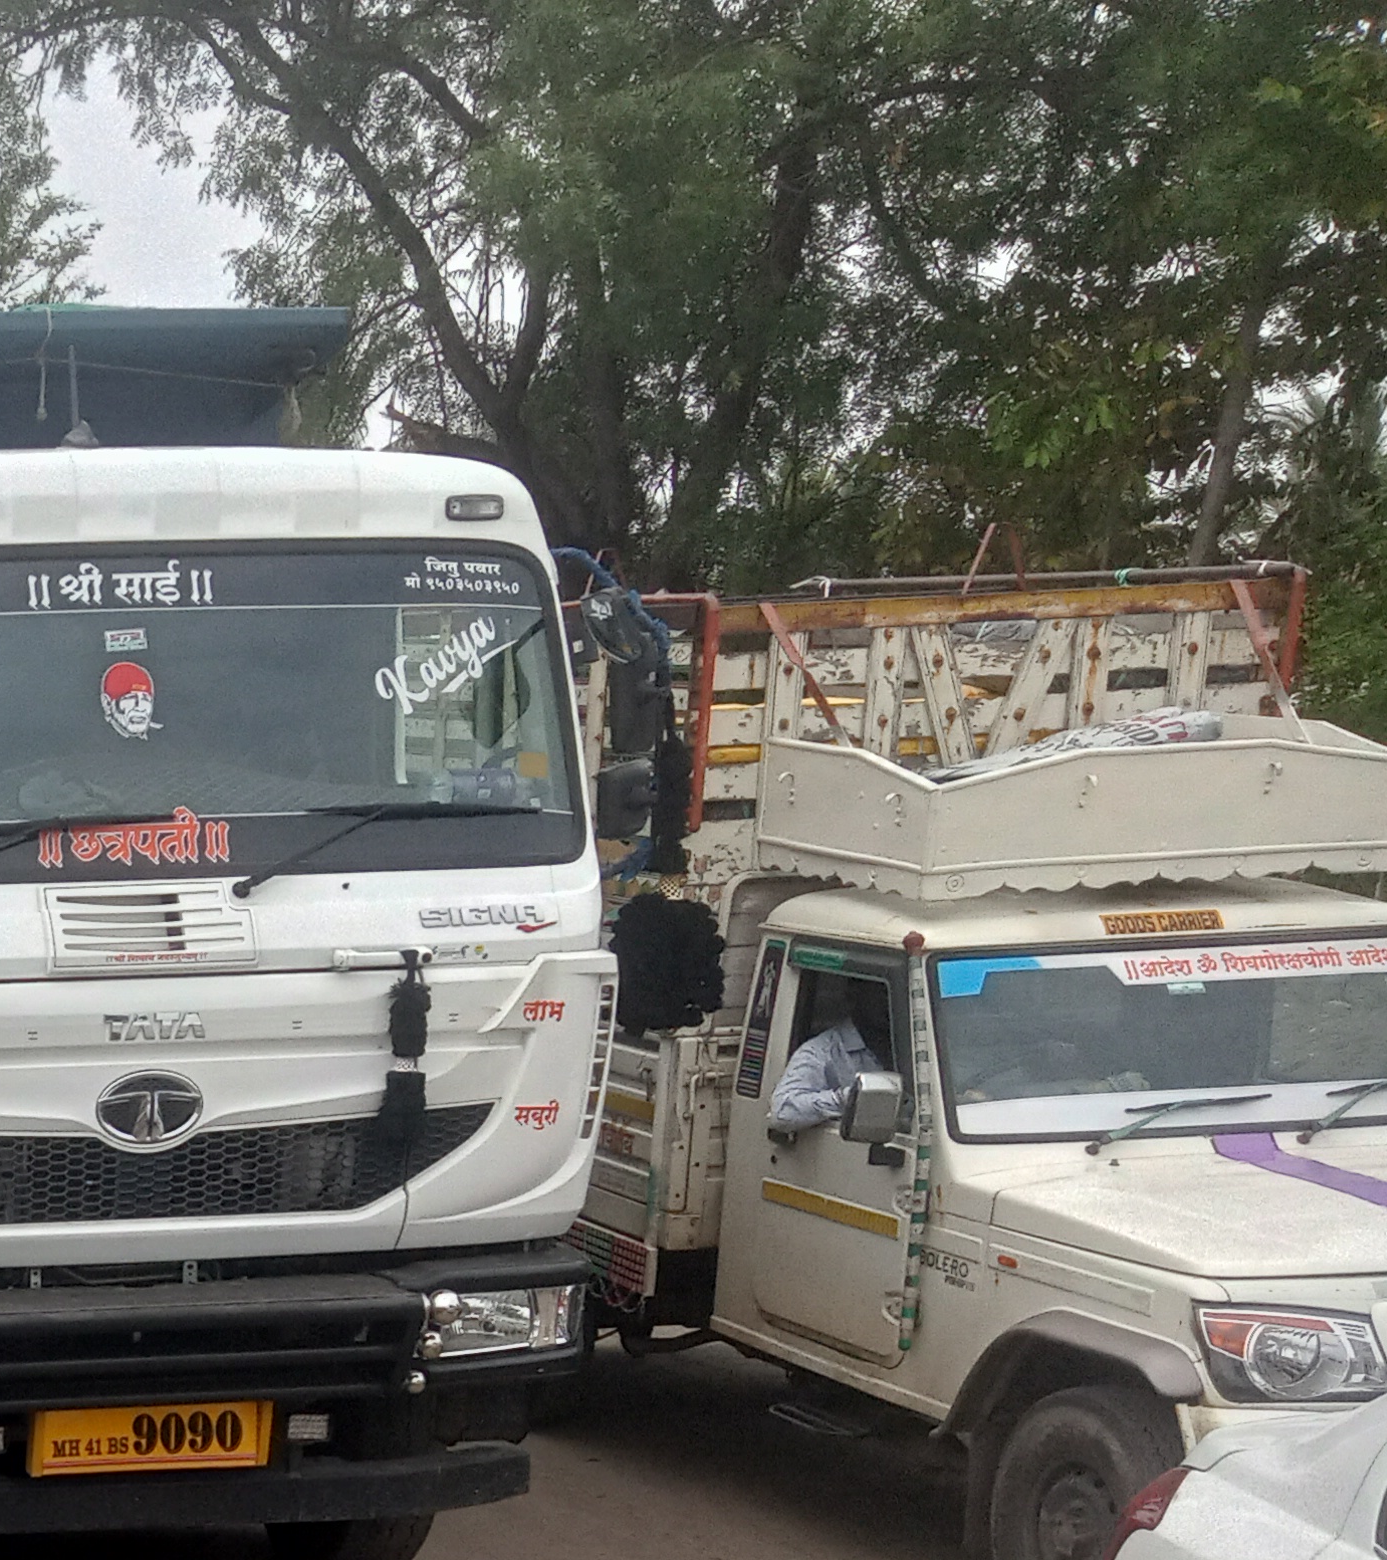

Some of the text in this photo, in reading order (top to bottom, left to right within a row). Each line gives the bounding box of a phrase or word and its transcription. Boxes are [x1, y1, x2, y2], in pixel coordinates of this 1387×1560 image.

[59, 562, 103, 605] श्री
[112, 560, 180, 605] साई
[463, 562, 501, 576] पवार
[375, 616, 496, 714] Kavya
[69, 806, 200, 866] छत्रपती
[419, 904, 545, 929] SIGNA
[1104, 910, 1221, 935] GOODS CARRIER
[103, 1011, 206, 1041] TATA
[523, 1000, 565, 1022] लाभ
[52, 1409, 243, 1458] MH 41 BS 9090
